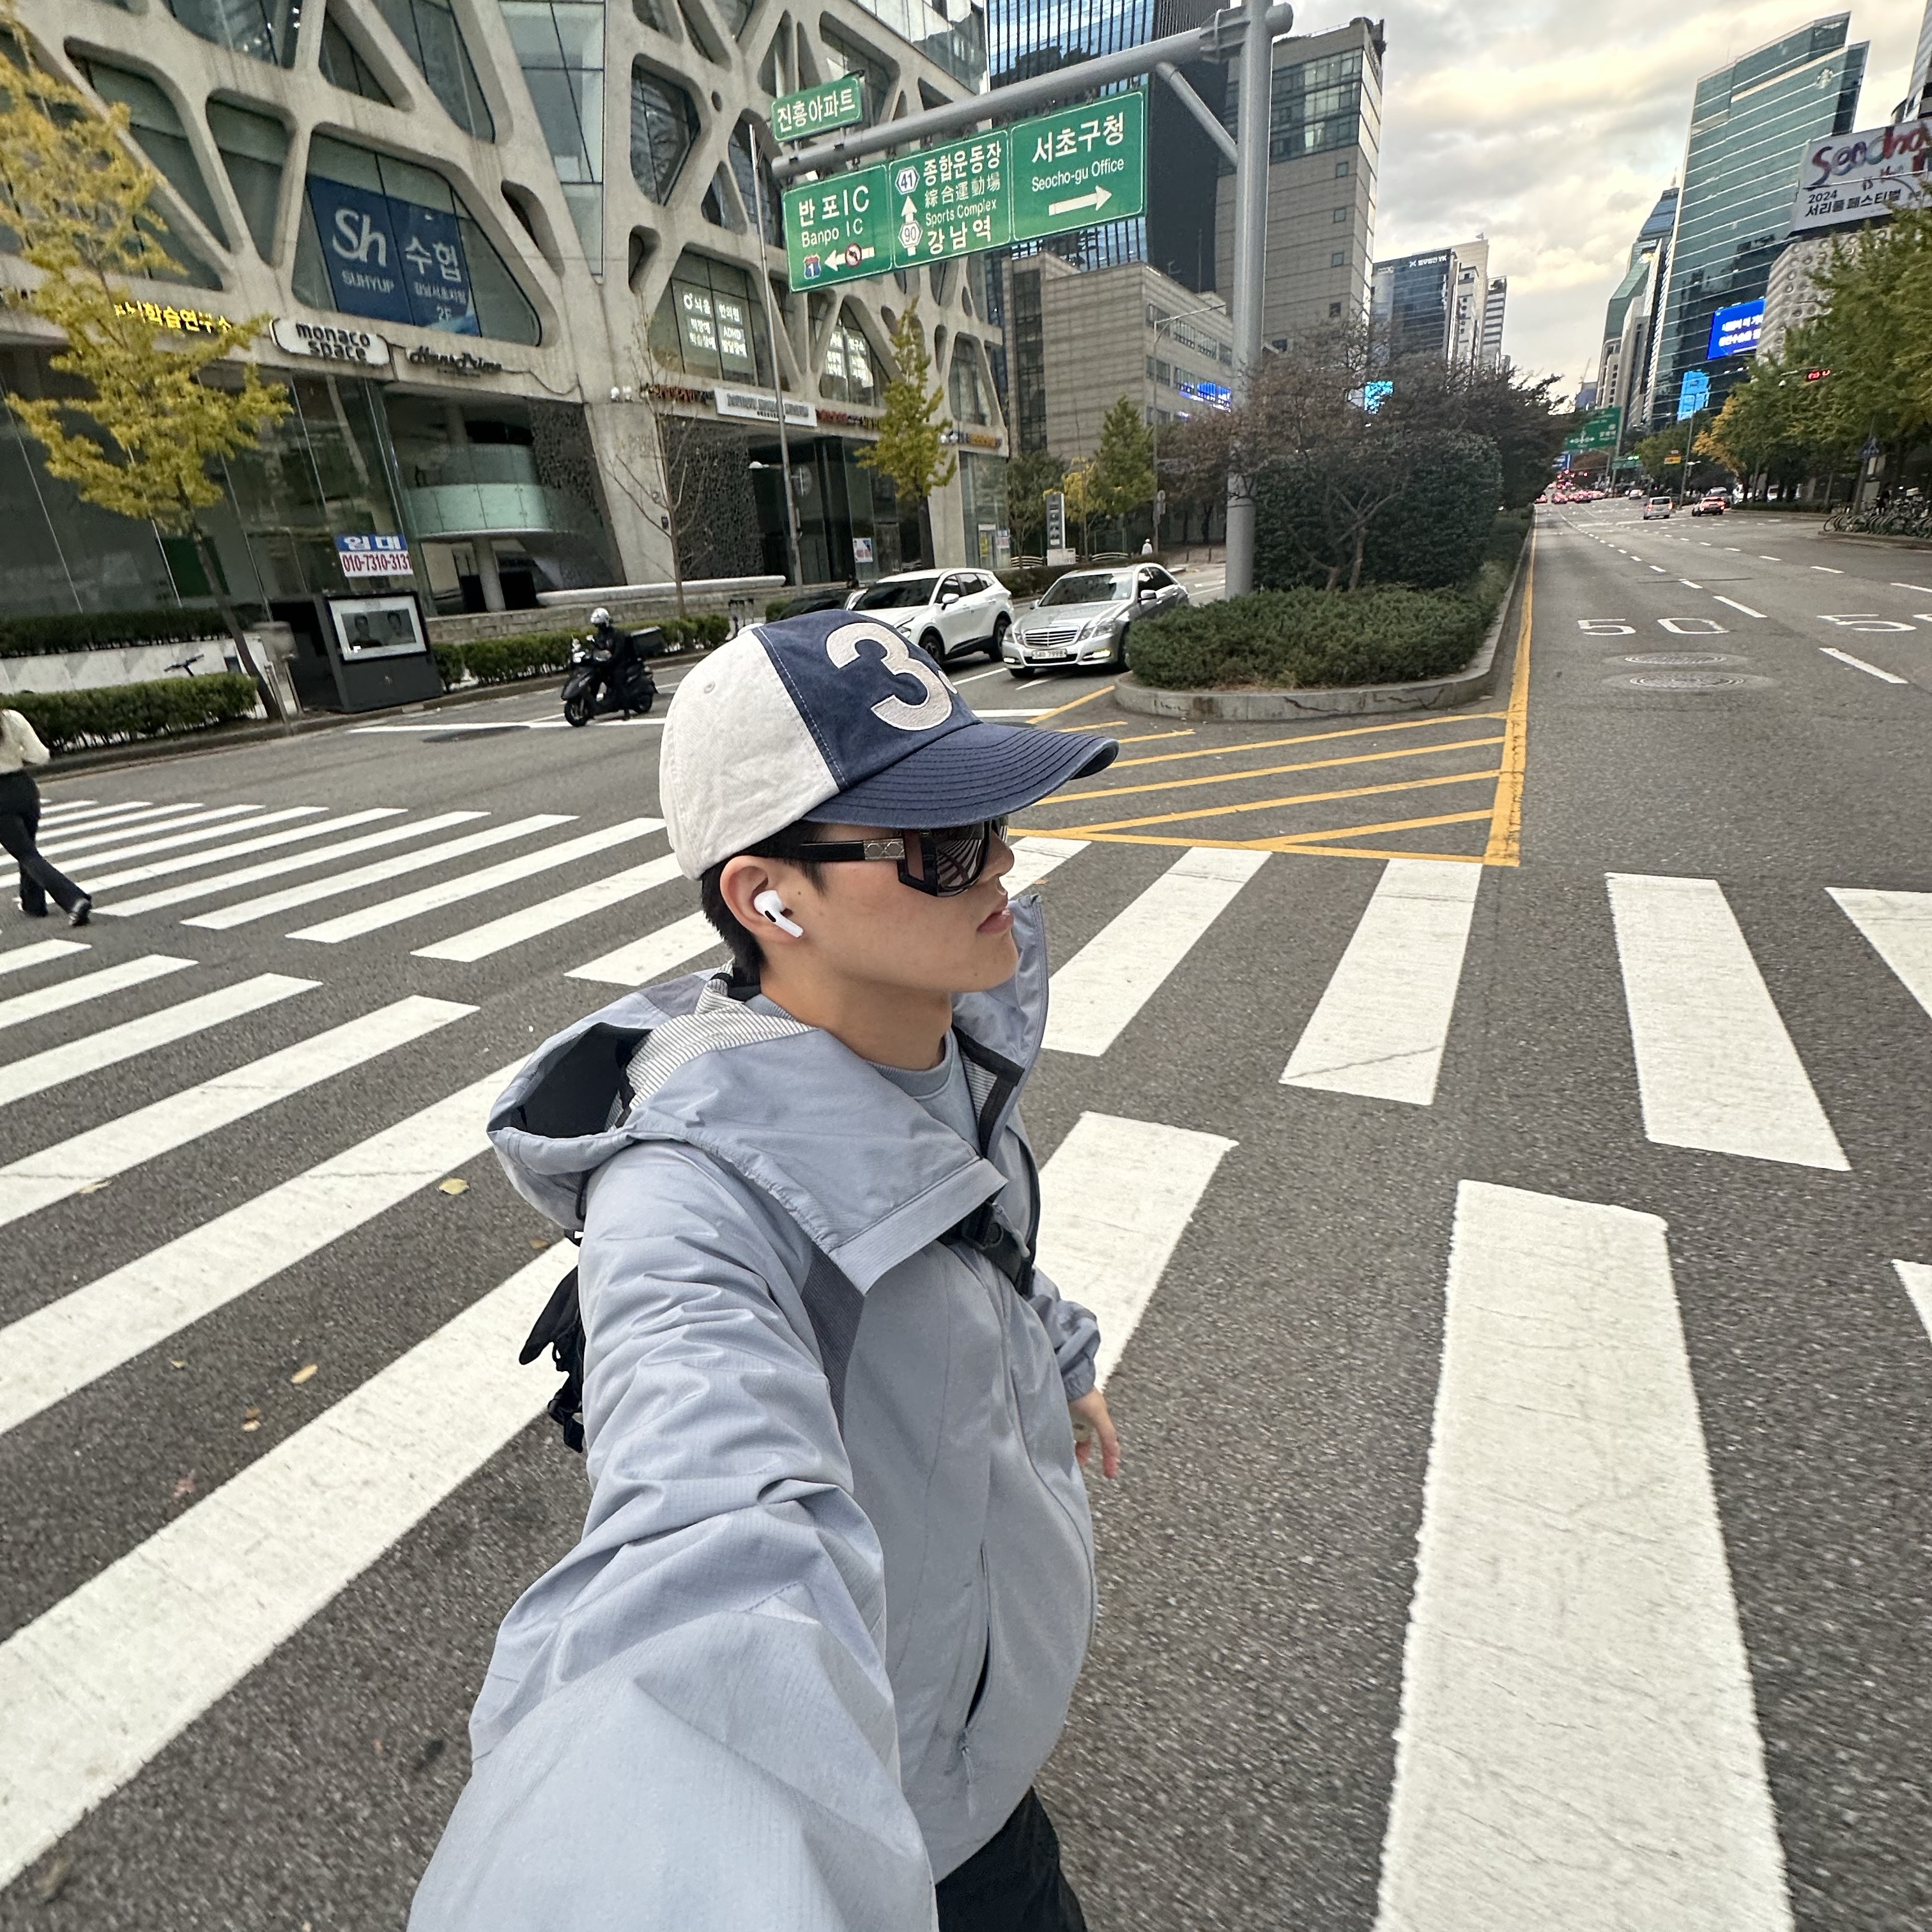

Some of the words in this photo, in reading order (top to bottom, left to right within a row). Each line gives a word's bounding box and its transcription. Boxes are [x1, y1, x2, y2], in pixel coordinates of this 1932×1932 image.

[778, 88, 855, 133] 진흥아파트
[1032, 112, 1124, 163] 서초구청
[923, 141, 1002, 186] 종합운동장
[1032, 167, 1089, 192] Seocho-gu
[1091, 158, 1124, 177] Office
[901, 172, 913, 190] 41
[1807, 190, 1837, 204] 2024
[926, 209, 954, 227] Sports
[957, 198, 997, 219] Complex
[332, 208, 387, 268] Sh
[801, 227, 839, 248] Banpo
[845, 217, 863, 238] IC
[904, 226, 917, 242] 90
[928, 215, 991, 255] 강남역
[404, 236, 462, 282] 수협
[808, 263, 815, 277] 1
[342, 269, 395, 295] SUHYUP
[296, 322, 371, 348] monaco
[308, 340, 367, 362] space
[343, 535, 402, 551] 임대
[342, 553, 413, 572] 010-7310-3131
[1577, 618, 1730, 636] 50
